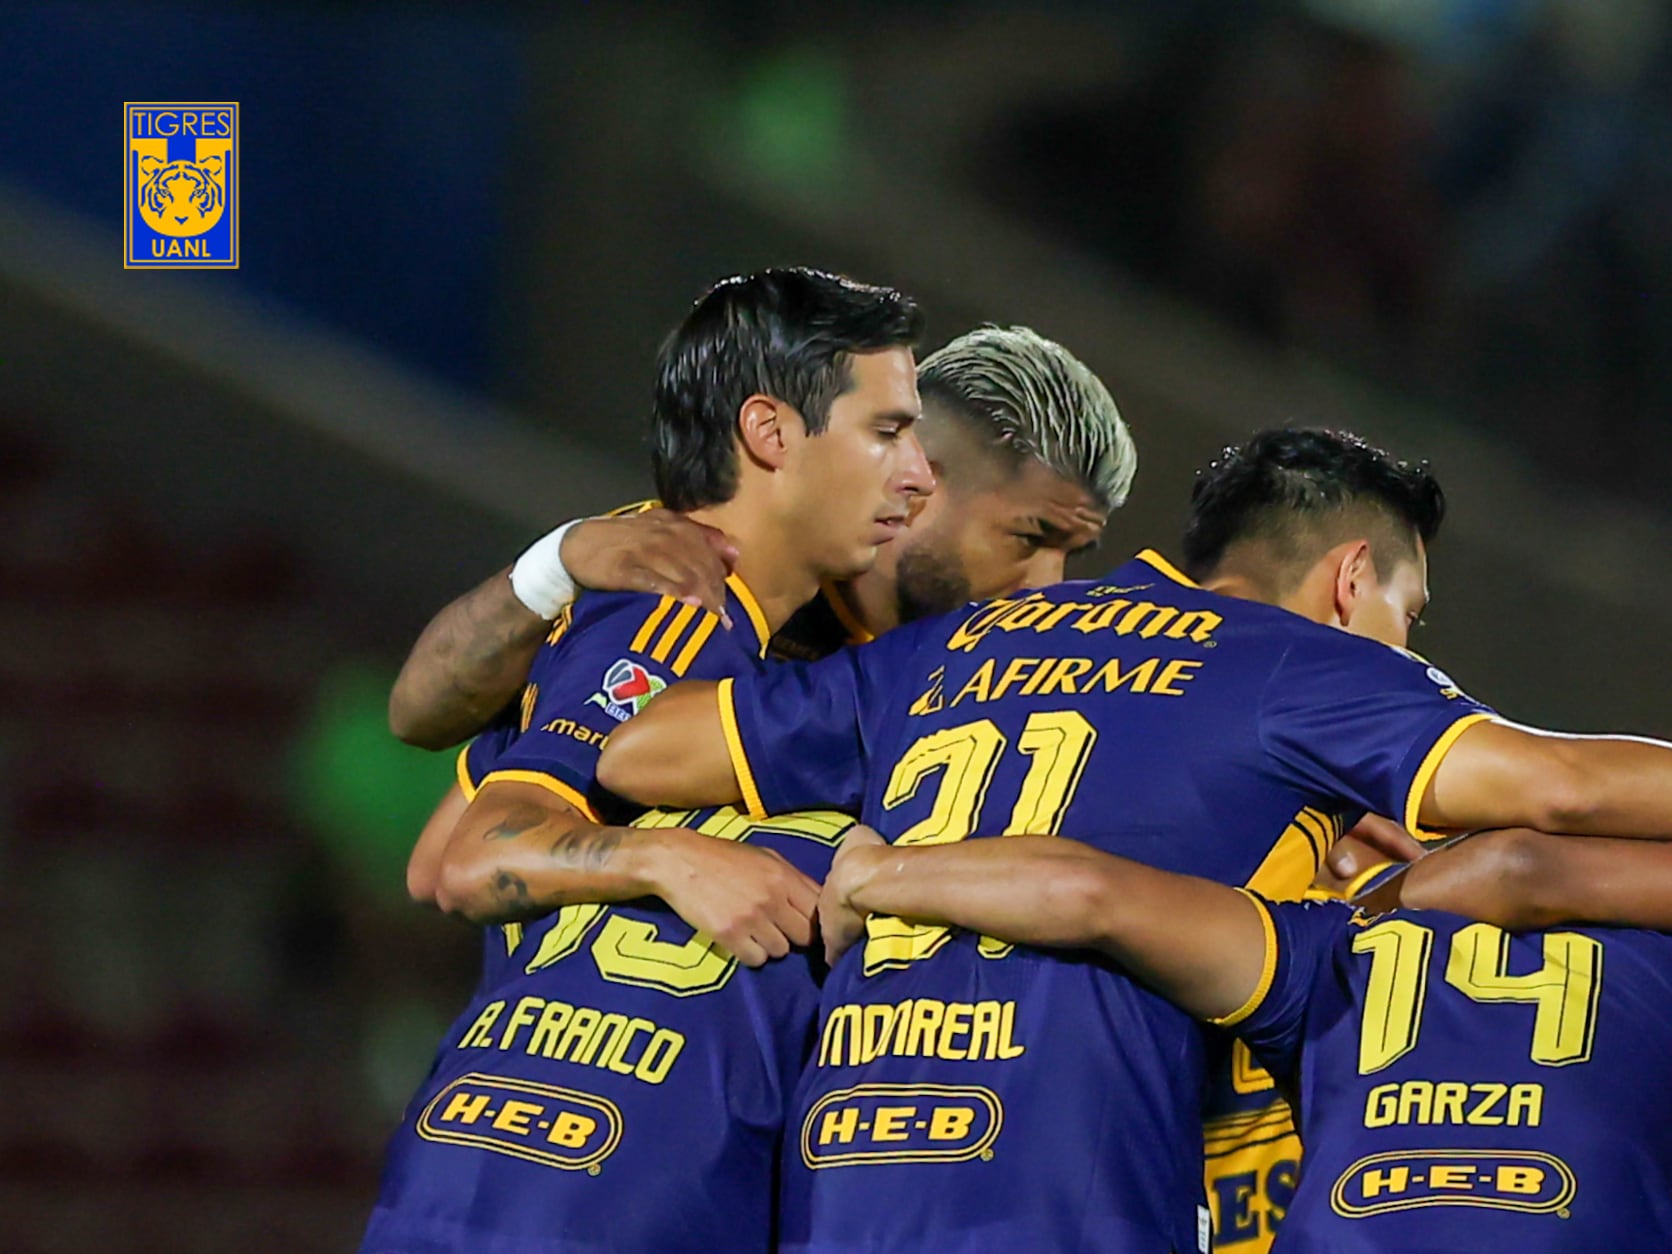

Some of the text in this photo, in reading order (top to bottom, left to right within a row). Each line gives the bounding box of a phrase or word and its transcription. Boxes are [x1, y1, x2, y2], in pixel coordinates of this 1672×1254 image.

[946, 592, 1224, 652] Corona
[948, 657, 1206, 708] AFIRME
[1351, 919, 1604, 1075] 14
[439, 1092, 597, 1149] H-E-B
[817, 1106, 976, 1146] H-E-B
[1363, 1080, 1544, 1128] GARZA
[1361, 1165, 1546, 1199] H-E-B
